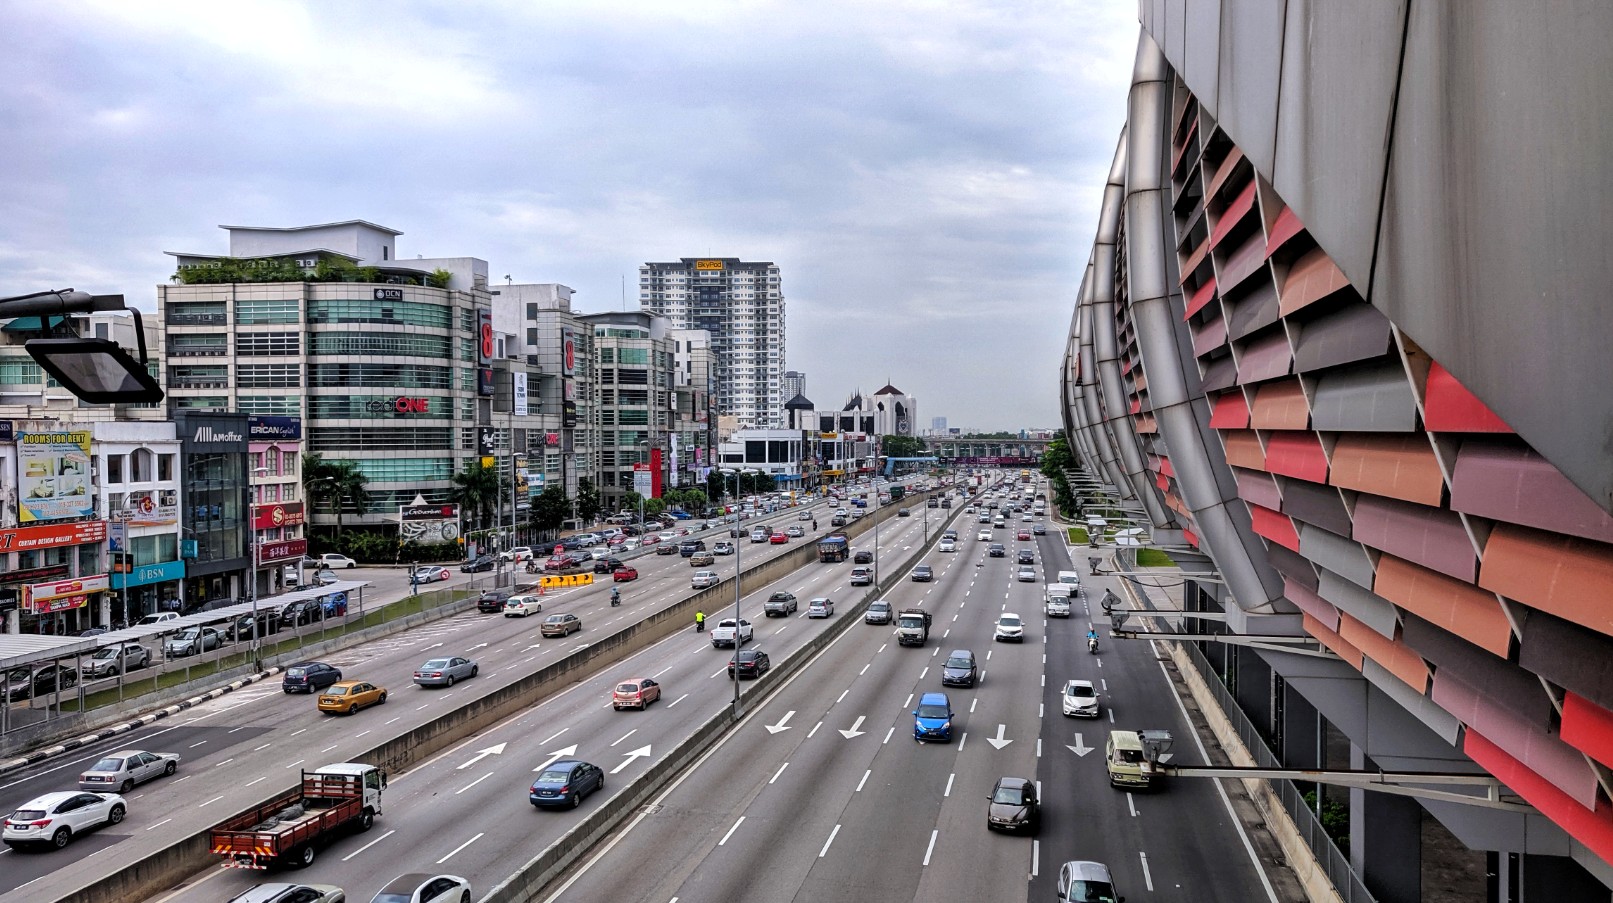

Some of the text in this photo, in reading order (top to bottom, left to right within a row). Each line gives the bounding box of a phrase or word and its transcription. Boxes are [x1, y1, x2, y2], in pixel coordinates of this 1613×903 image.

[697, 261, 722, 269] SkyPod
[24, 434, 85, 444] ROOMS FOR RENT
[18, 539, 37, 547] CURTAIN
[54, 535, 73, 543] GALLERY
[147, 567, 164, 580] BSN
